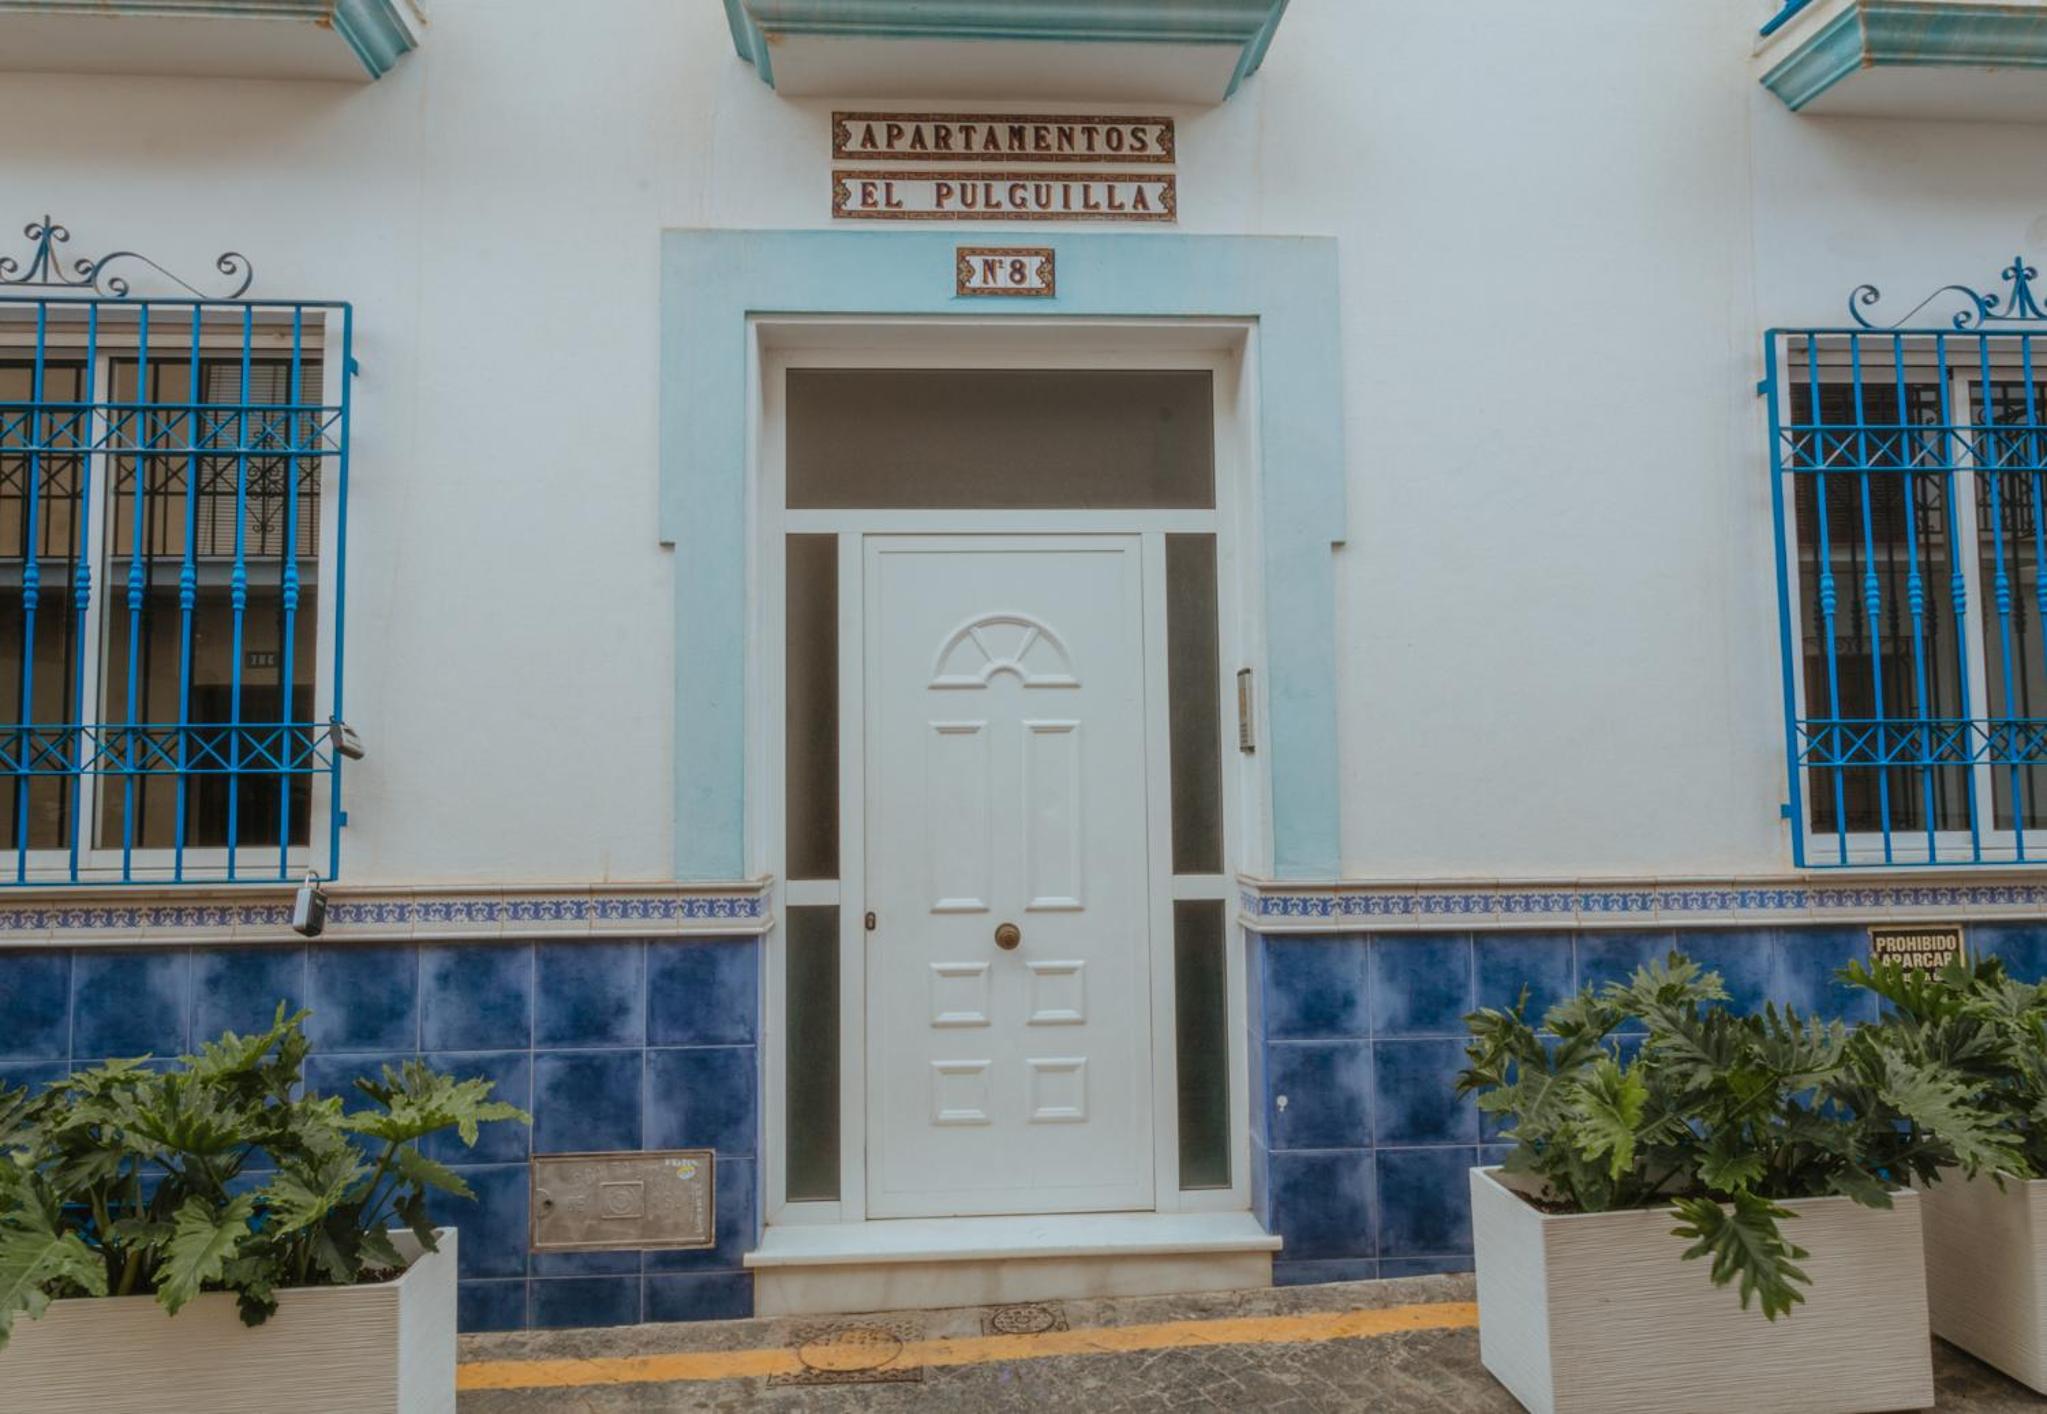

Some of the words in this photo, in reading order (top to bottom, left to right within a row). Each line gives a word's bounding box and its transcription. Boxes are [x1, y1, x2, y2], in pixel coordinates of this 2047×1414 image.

[860, 123, 1148, 152] APARTAMENTOS
[860, 181, 903, 208] EL
[935, 182, 1150, 210] PULGUILLA
[1875, 935, 1957, 952] PROHIBIDO
